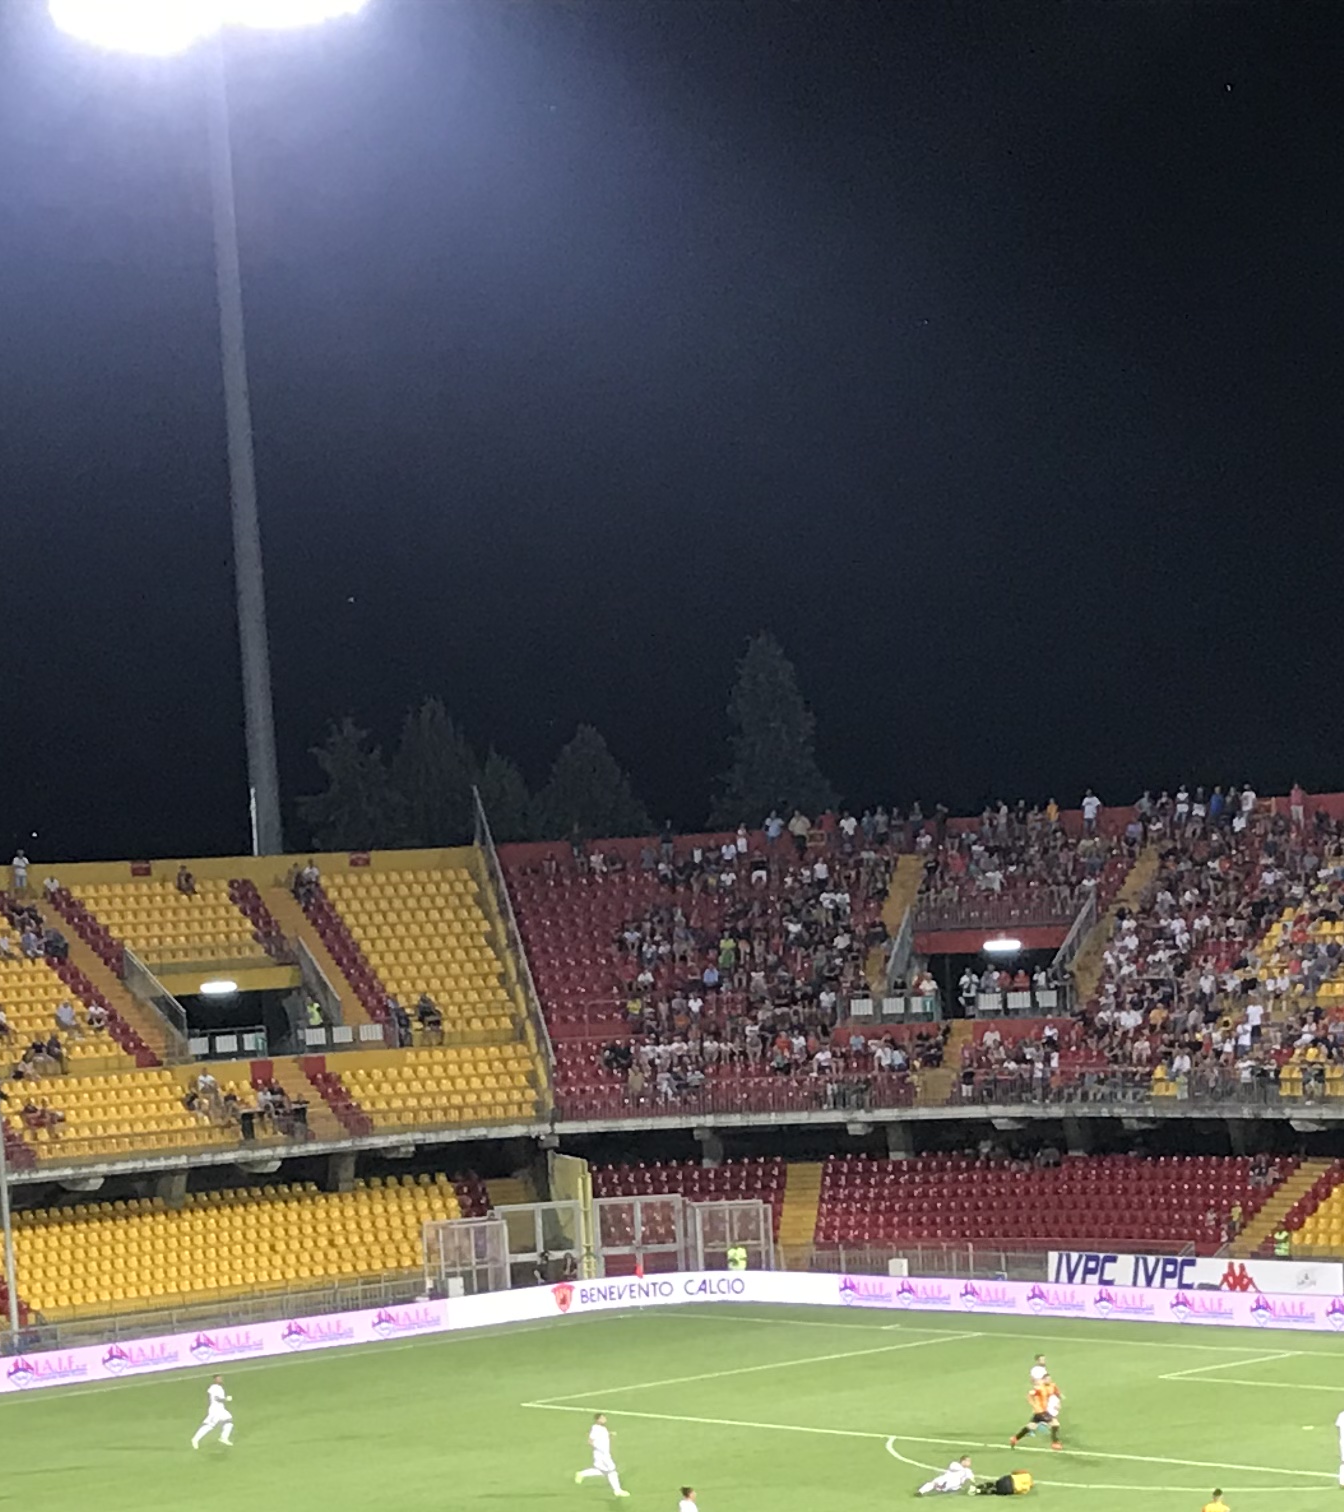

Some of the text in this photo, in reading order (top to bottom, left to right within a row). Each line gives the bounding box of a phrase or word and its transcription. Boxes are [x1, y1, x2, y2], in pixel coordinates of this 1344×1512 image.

[1054, 1252, 1197, 1290] IVPC IVPC
[579, 1277, 746, 1305] BENEVENTO CALCIO
